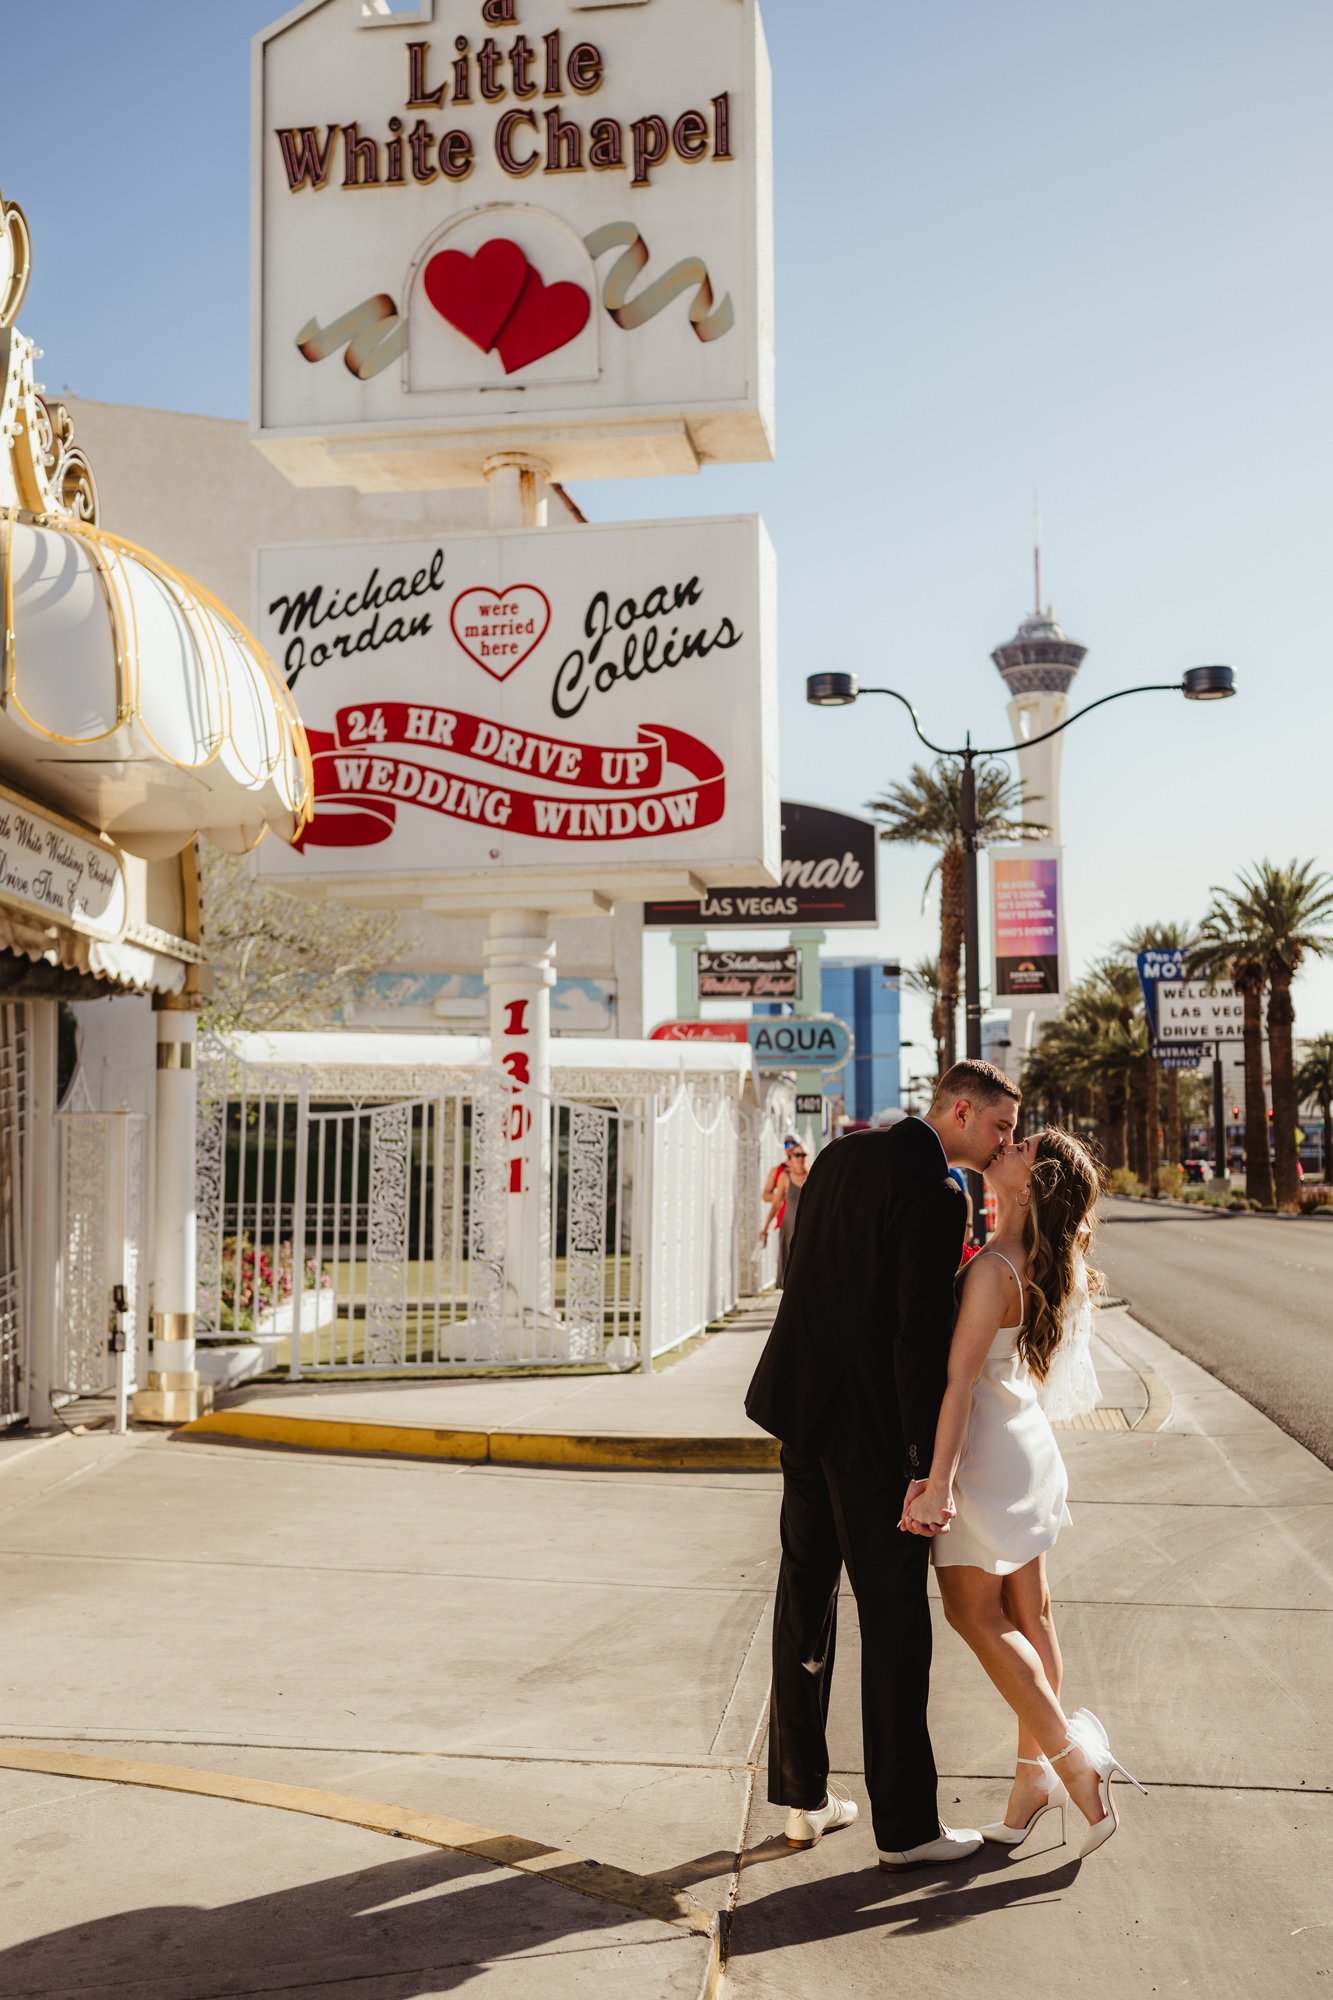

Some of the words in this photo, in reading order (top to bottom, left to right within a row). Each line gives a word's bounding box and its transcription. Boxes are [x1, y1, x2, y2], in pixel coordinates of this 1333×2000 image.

[405, 29, 604, 109] Little
[275, 117, 475, 192] White
[495, 91, 734, 188] Chapel
[269, 548, 445, 635] Michael
[479, 603, 519, 616] were
[585, 576, 704, 664] Joan
[285, 612, 433, 691] Jordan
[464, 618, 535, 637] married
[481, 641, 519, 656] here
[552, 617, 744, 718] Collins
[347, 707, 387, 741] 24
[404, 707, 458, 746] HR
[470, 722, 582, 780] DRIVE
[600, 751, 650, 784] UP
[333, 758, 513, 825] WEDDING
[533, 781, 699, 836] WINDOW
[781, 851, 865, 889] mar
[700, 898, 733, 916] LAS
[736, 896, 798, 916] VEGAS
[755, 1028, 836, 1053] AQUA
[1163, 1025, 1209, 1037] DRIVE
[1171, 1006, 1201, 1018] LAS
